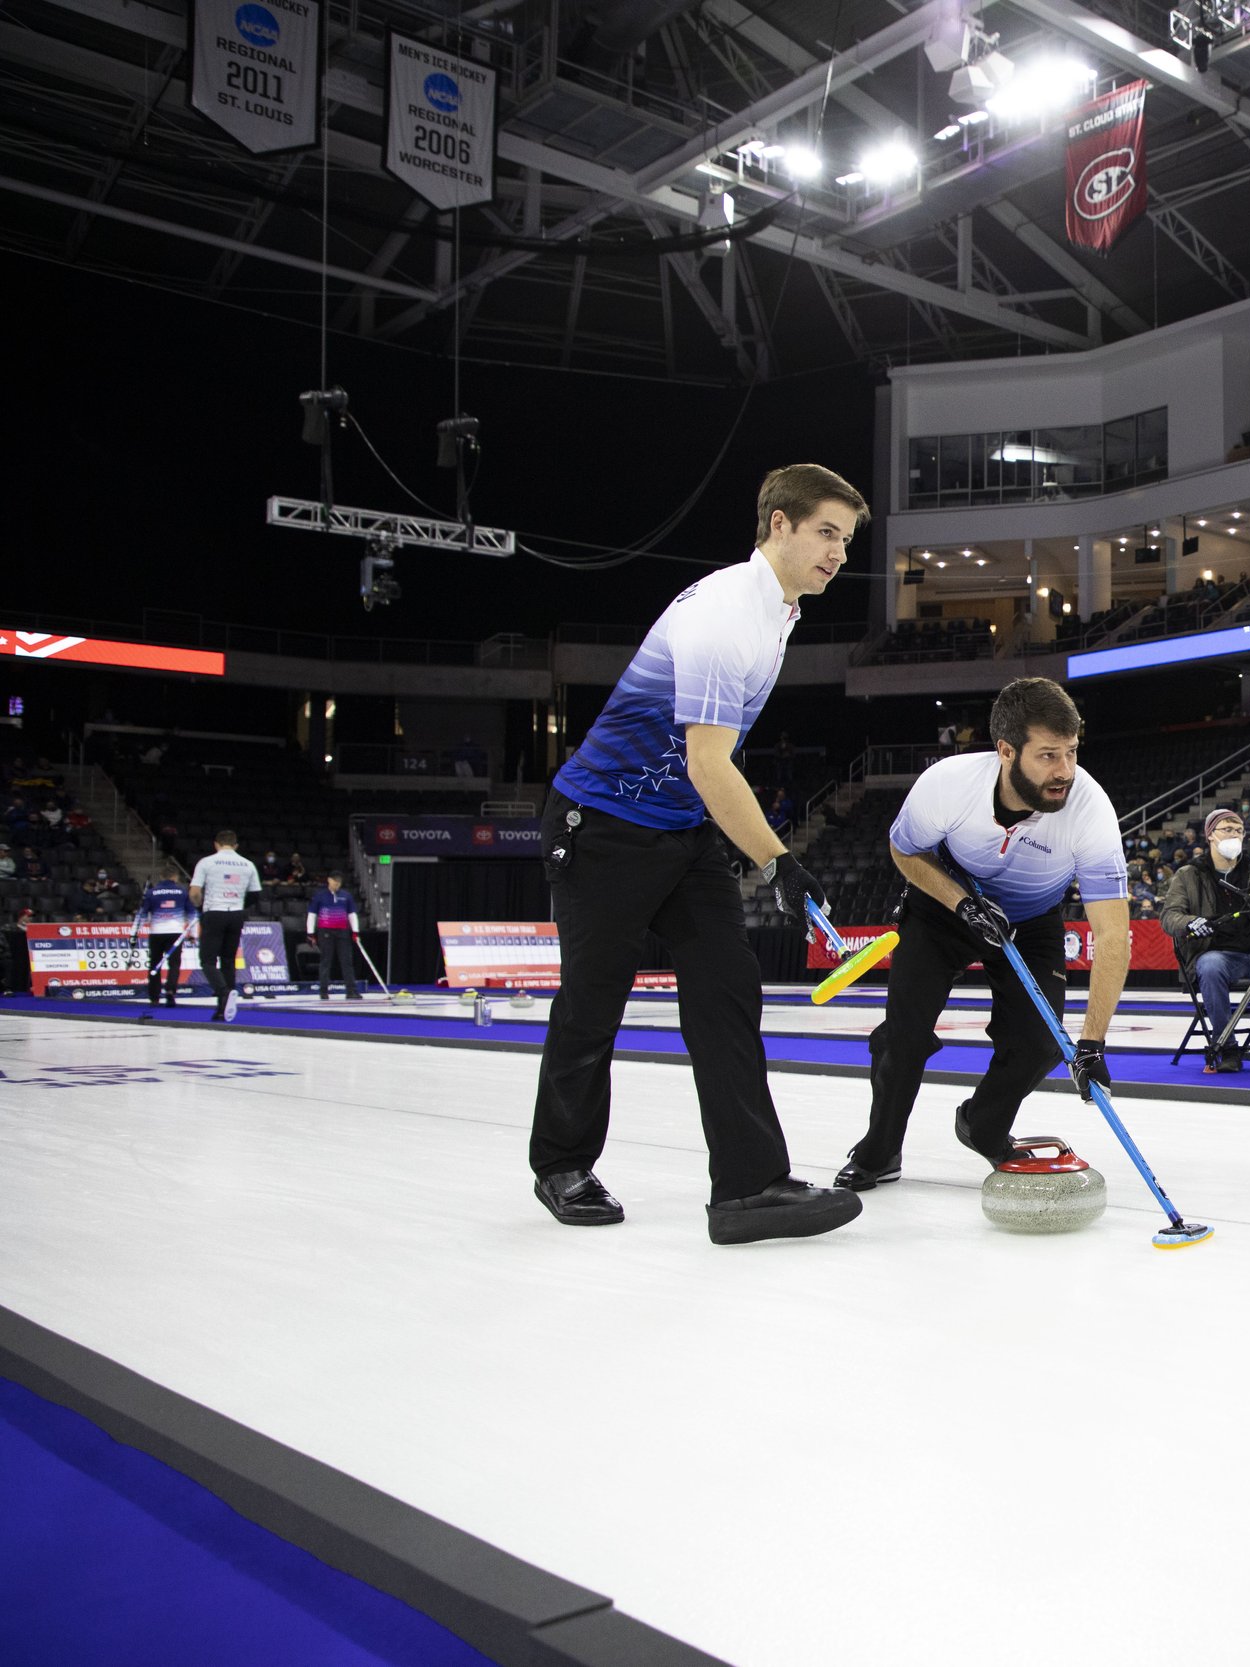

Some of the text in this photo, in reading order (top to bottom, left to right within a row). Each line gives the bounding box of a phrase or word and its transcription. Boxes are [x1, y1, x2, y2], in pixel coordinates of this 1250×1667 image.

[216, 36, 297, 74] REGIONAL
[398, 43, 487, 85] MEN'S ICE HOCKEY
[226, 61, 284, 104] 2011
[218, 91, 294, 126] ST. LOUIS
[408, 103, 477, 137] REGIONAL
[1083, 109, 1114, 132] CLOUD
[414, 125, 470, 165] 2006
[399, 151, 483, 187] WORCESTER
[403, 758, 428, 769] 124
[402, 829, 451, 840] TOYOTA
[91, 926, 120, 935] OLYMPIC
[34, 941, 52, 949] END
[110, 950, 118, 959] 2
[81, 978, 117, 986] CURLING
[102, 989, 135, 997] CURLING
